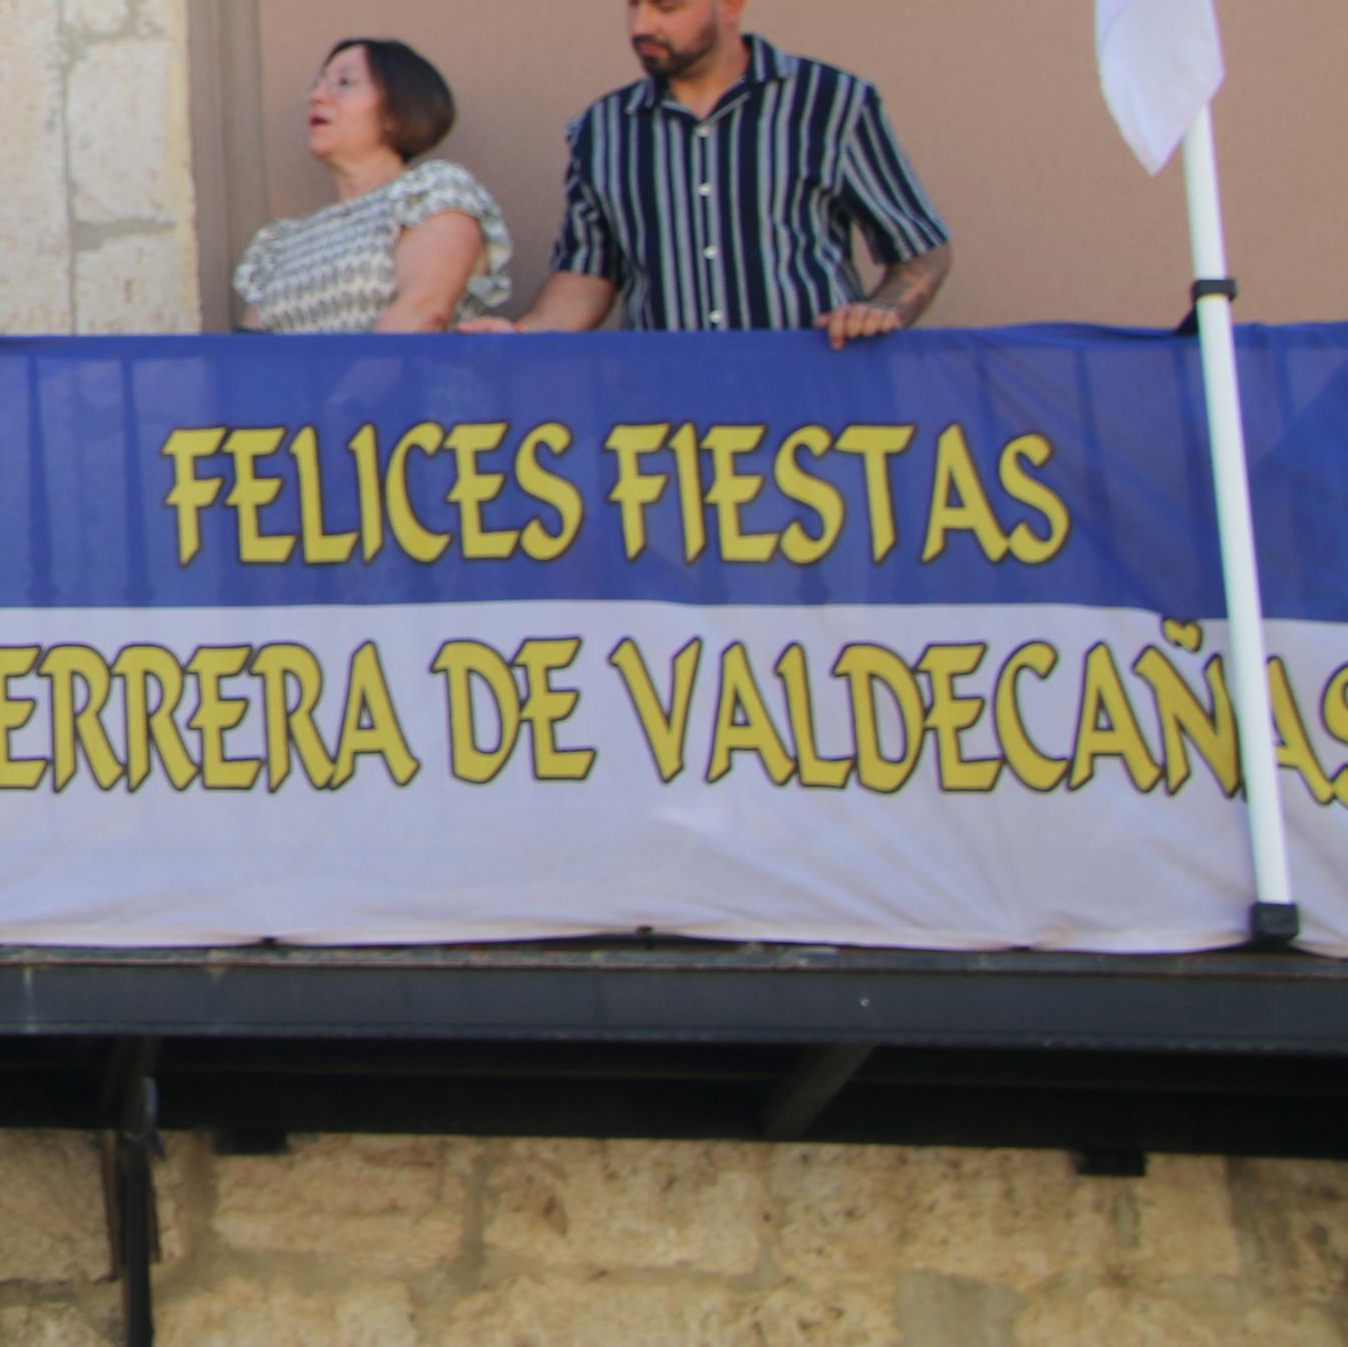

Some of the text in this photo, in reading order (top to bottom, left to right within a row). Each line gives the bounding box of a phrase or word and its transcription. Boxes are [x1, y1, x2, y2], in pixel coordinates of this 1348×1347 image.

[160, 421, 1071, 568] FELICES FIESTAS
[430, 637, 598, 784] DE
